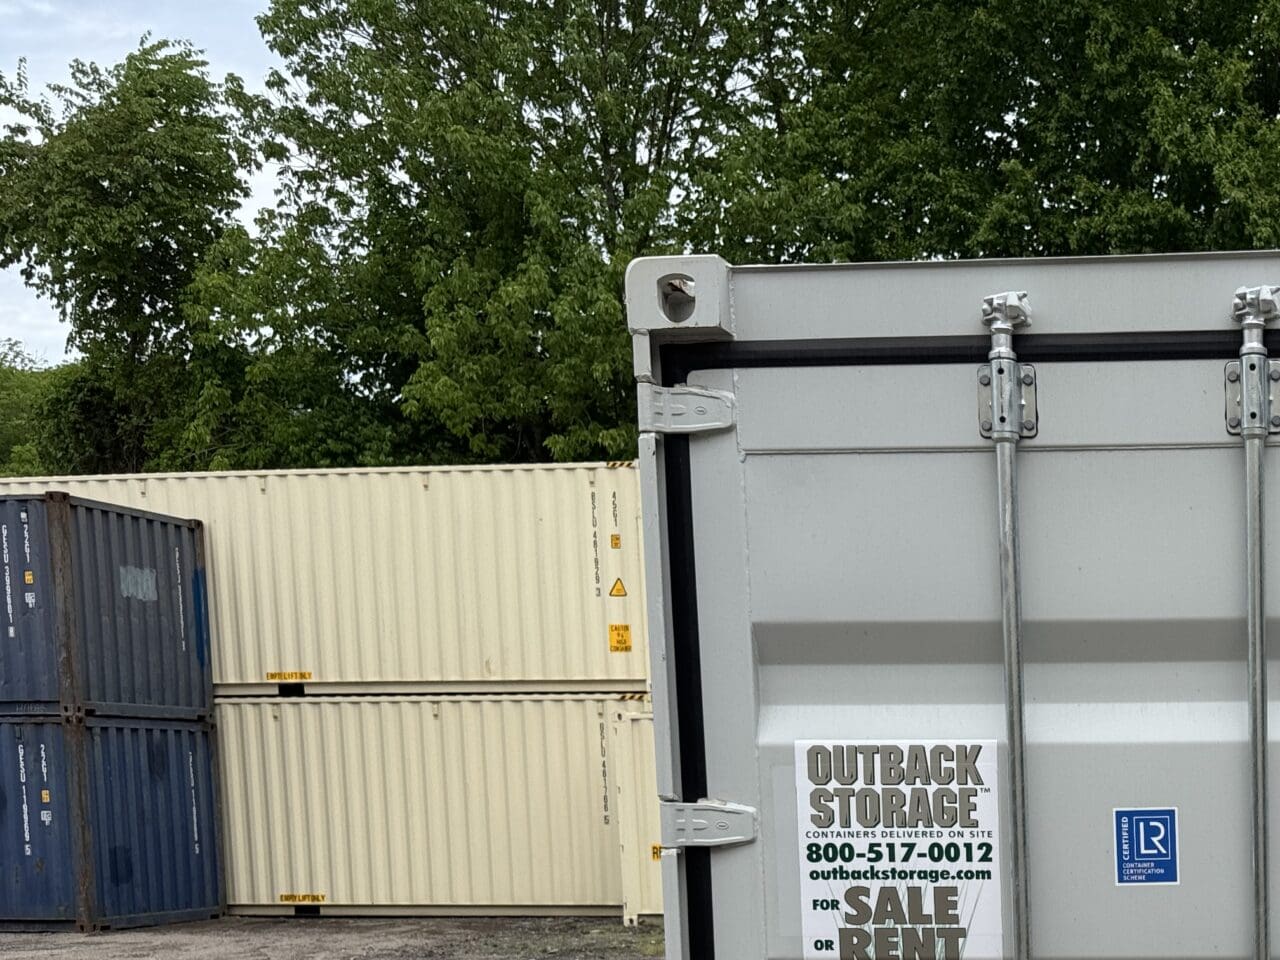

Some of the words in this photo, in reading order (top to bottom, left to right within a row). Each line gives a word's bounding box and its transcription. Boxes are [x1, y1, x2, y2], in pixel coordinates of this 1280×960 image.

[806, 745, 984, 786] OUTBACK
[809, 787, 979, 828] STORAGE
[805, 831, 877, 839] CONTAINERS
[881, 831, 944, 839] DELIVERED
[1139, 821, 1167, 854] LR
[806, 842, 993, 863] 800-517-0012
[809, 865, 992, 882] outbackstorage.com
[812, 899, 840, 910] FOR
[844, 886, 960, 925] SALE
[814, 940, 834, 951] OR
